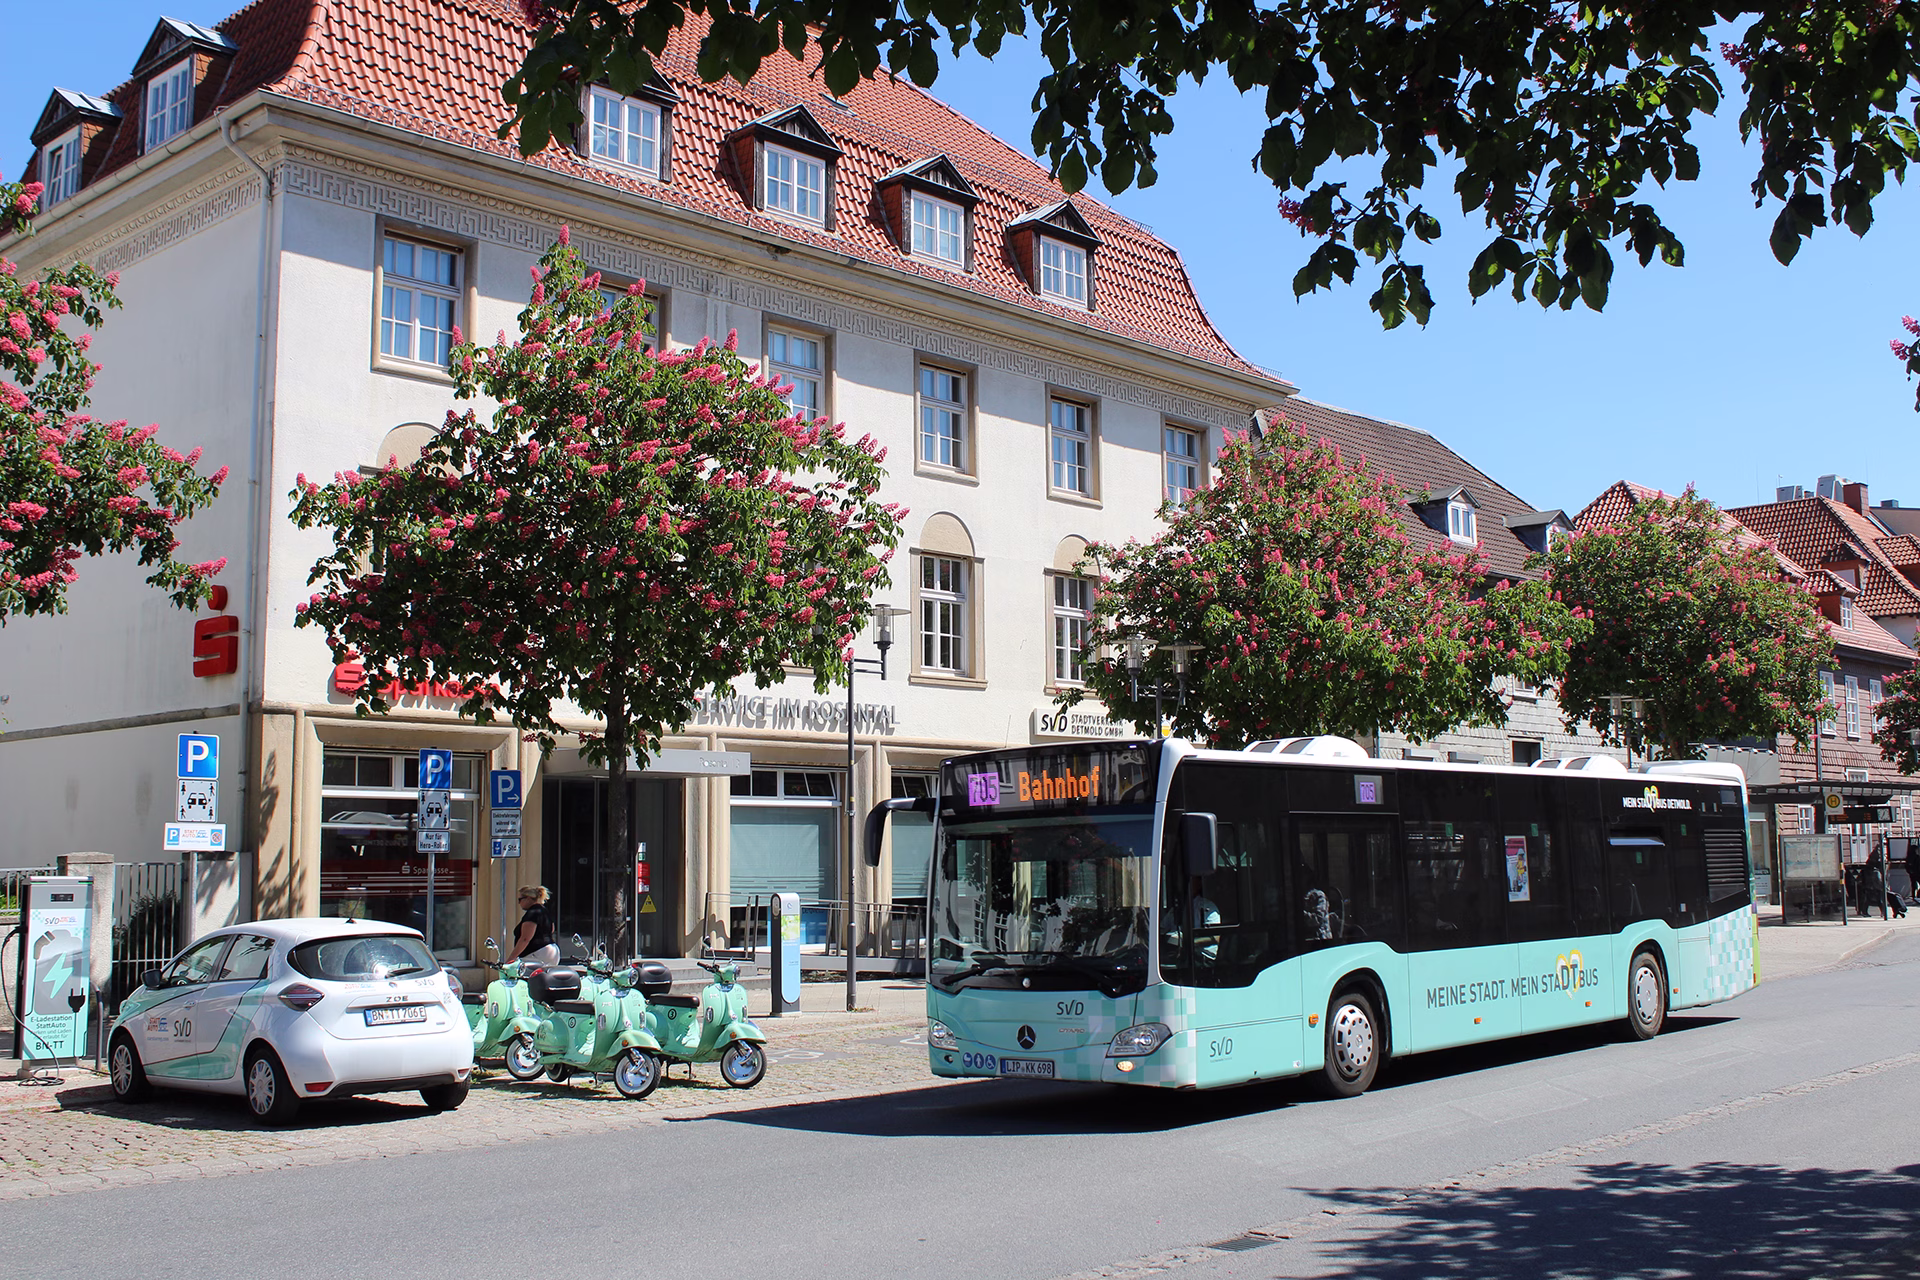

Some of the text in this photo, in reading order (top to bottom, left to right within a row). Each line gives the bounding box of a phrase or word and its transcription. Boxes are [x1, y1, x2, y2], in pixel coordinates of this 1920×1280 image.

[778, 697, 801, 719] IM
[808, 700, 900, 725] ROSNTAL
[1040, 713, 1068, 732] SVD
[1071, 725, 1124, 737] DETMOLD GMBH
[186, 740, 210, 773] P
[426, 754, 445, 784] P
[497, 775, 515, 804] P
[969, 765, 1100, 803] 705 Bahnhof
[1360, 783, 1375, 801] 705
[1622, 797, 1637, 808] MEIN
[169, 830, 179, 840] P
[435, 832, 443, 840] für
[420, 841, 447, 849] Hero-Roller
[413, 865, 449, 875] Sparasse
[1427, 963, 1599, 1009] MEINE STADT. MEIN STADTBUS
[371, 1009, 384, 1022] BN
[1056, 999, 1085, 1016] SVD
[30, 1015, 73, 1023] E-Ladestation
[173, 1017, 192, 1037] SVD
[1209, 1036, 1234, 1058] SVD
[1006, 1061, 1052, 1074] LIP KK 698
